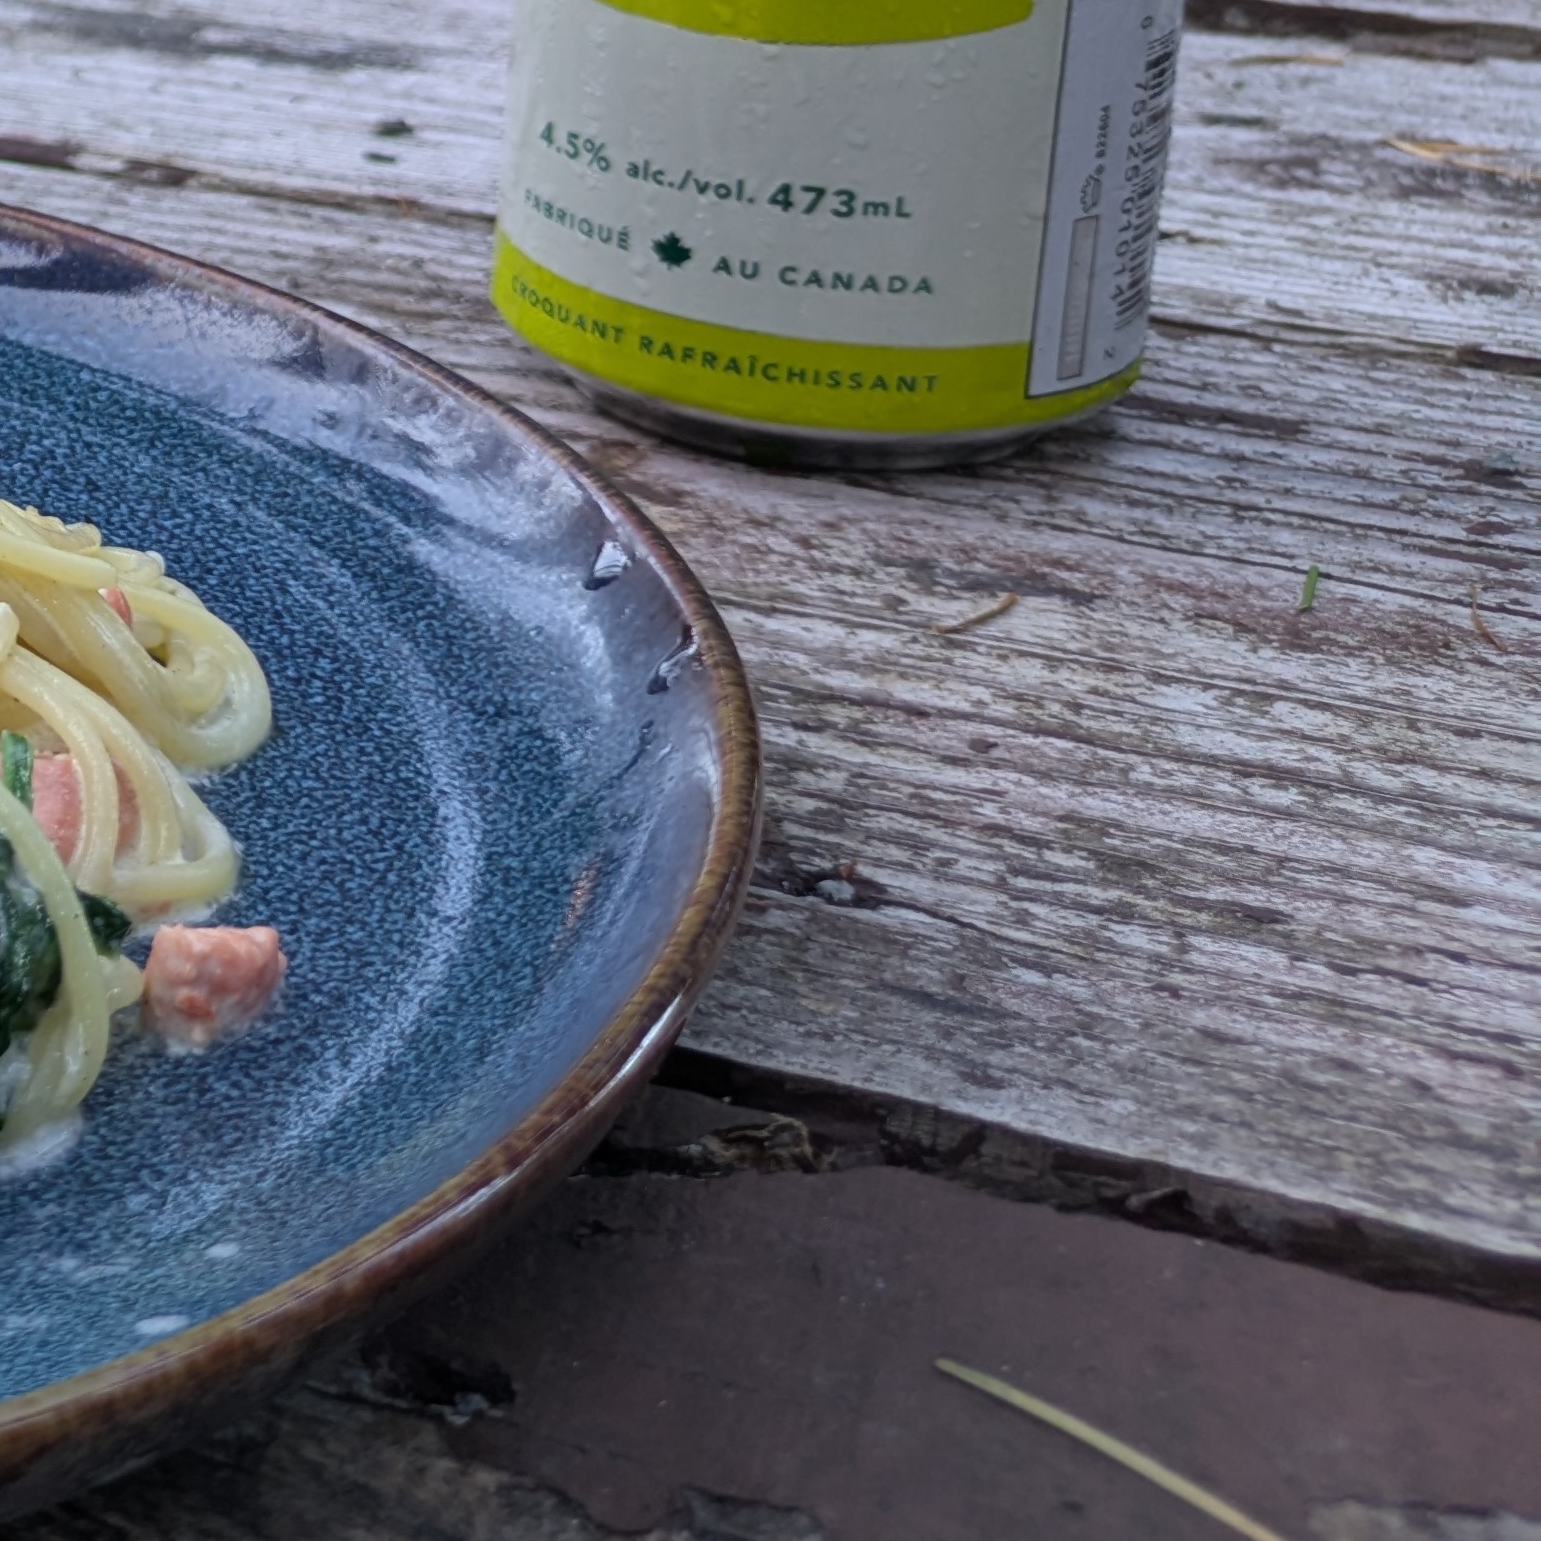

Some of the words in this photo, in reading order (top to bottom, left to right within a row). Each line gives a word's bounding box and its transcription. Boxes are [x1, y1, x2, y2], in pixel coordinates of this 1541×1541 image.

[540, 122, 612, 173] 4.5%
[625, 158, 756, 205] alc./vol.
[767, 183, 912, 219] 473mL
[525, 188, 631, 251] FABRIQUÉ
[712, 255, 759, 281] AU
[778, 266, 934, 296] CANADA
[511, 275, 624, 344] CROQUANT
[638, 334, 940, 394] RAFRAÎCHISSANT
